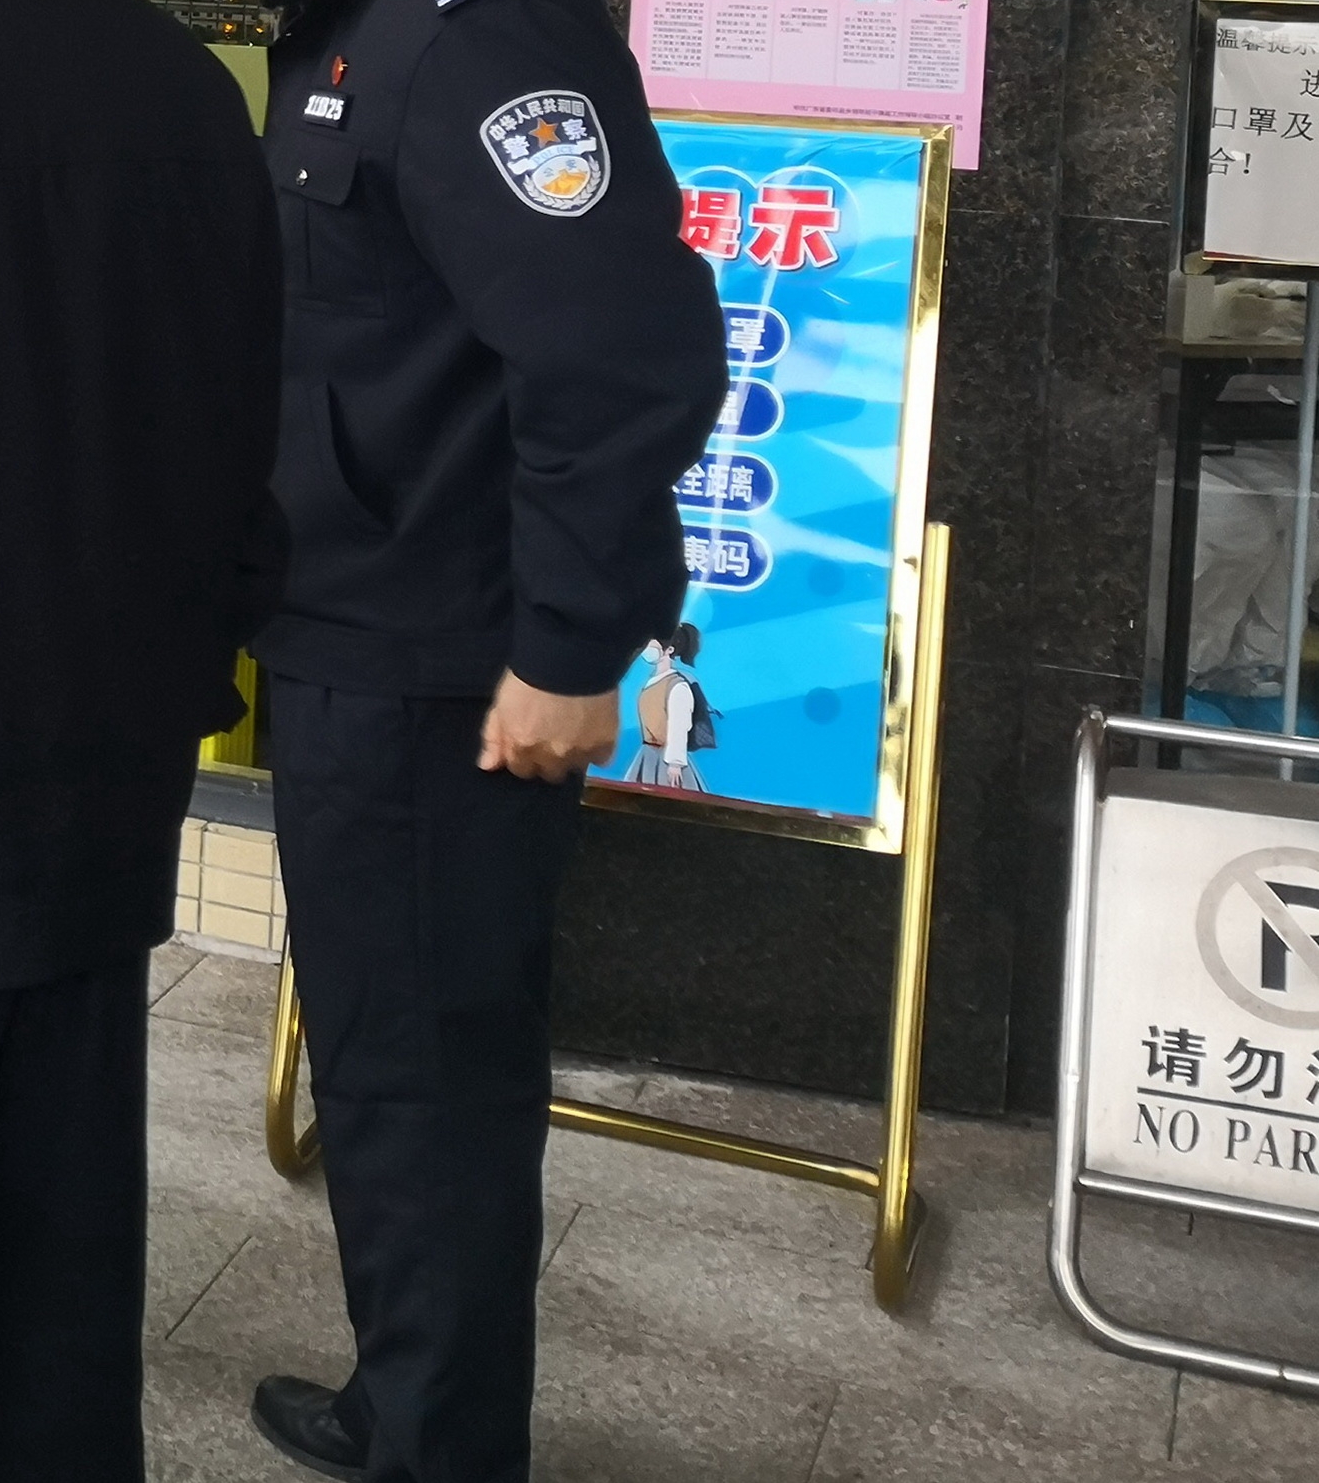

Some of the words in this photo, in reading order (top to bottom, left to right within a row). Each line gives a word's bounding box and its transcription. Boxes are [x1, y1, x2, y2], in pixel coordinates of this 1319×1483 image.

[489, 98, 585, 141] 中华人民共和国
[1212, 106, 1314, 141] 口罩及
[678, 185, 840, 271] 提示
[726, 317, 766, 354] 罩
[672, 464, 754, 503] 全距离
[1142, 1025, 1319, 1105] 请勿
[1133, 1102, 1201, 1154] NO
[1224, 1117, 1319, 1176] PAR
